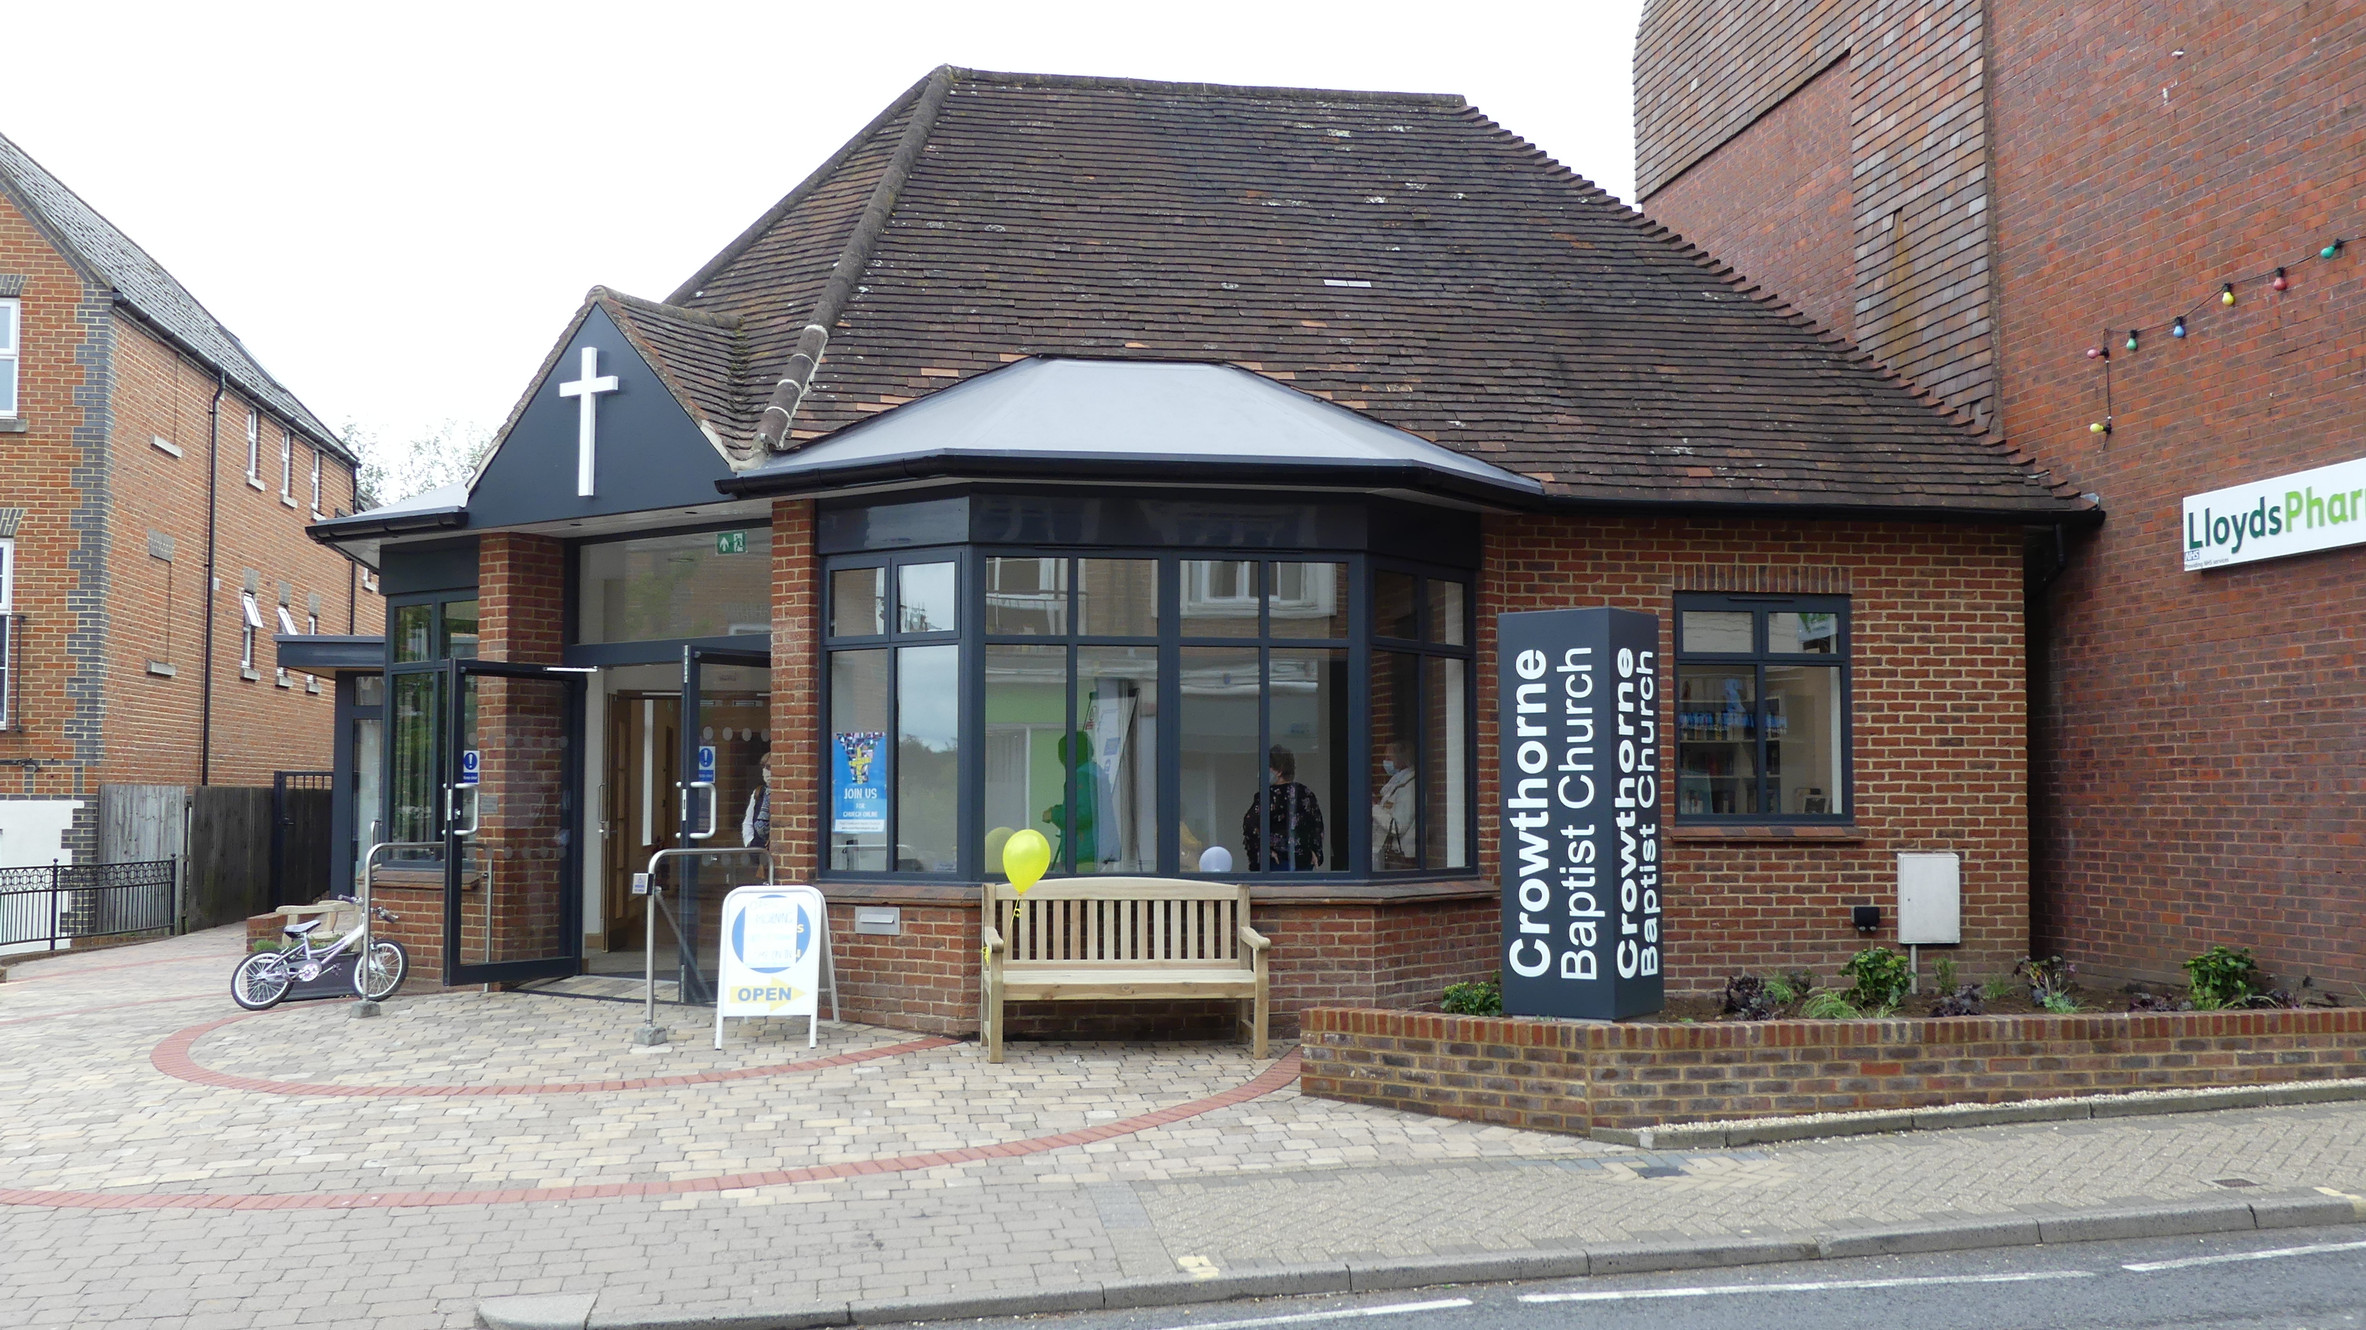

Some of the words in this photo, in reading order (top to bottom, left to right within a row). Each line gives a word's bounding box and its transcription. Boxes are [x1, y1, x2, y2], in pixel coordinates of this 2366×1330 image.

[2185, 550, 2200, 561] NHS
[2188, 486, 2366, 554] LloydsPhar
[844, 788, 862, 799] JOIN
[865, 788, 878, 799] US
[1557, 647, 1594, 809] Church
[1636, 650, 1655, 809] Church
[1508, 649, 1551, 978] Crowthorne
[1615, 647, 1638, 979] Crowthorne
[1559, 824, 1606, 980] Baptist
[1639, 823, 1660, 976] Baptist
[738, 987, 791, 1001] OPEN
